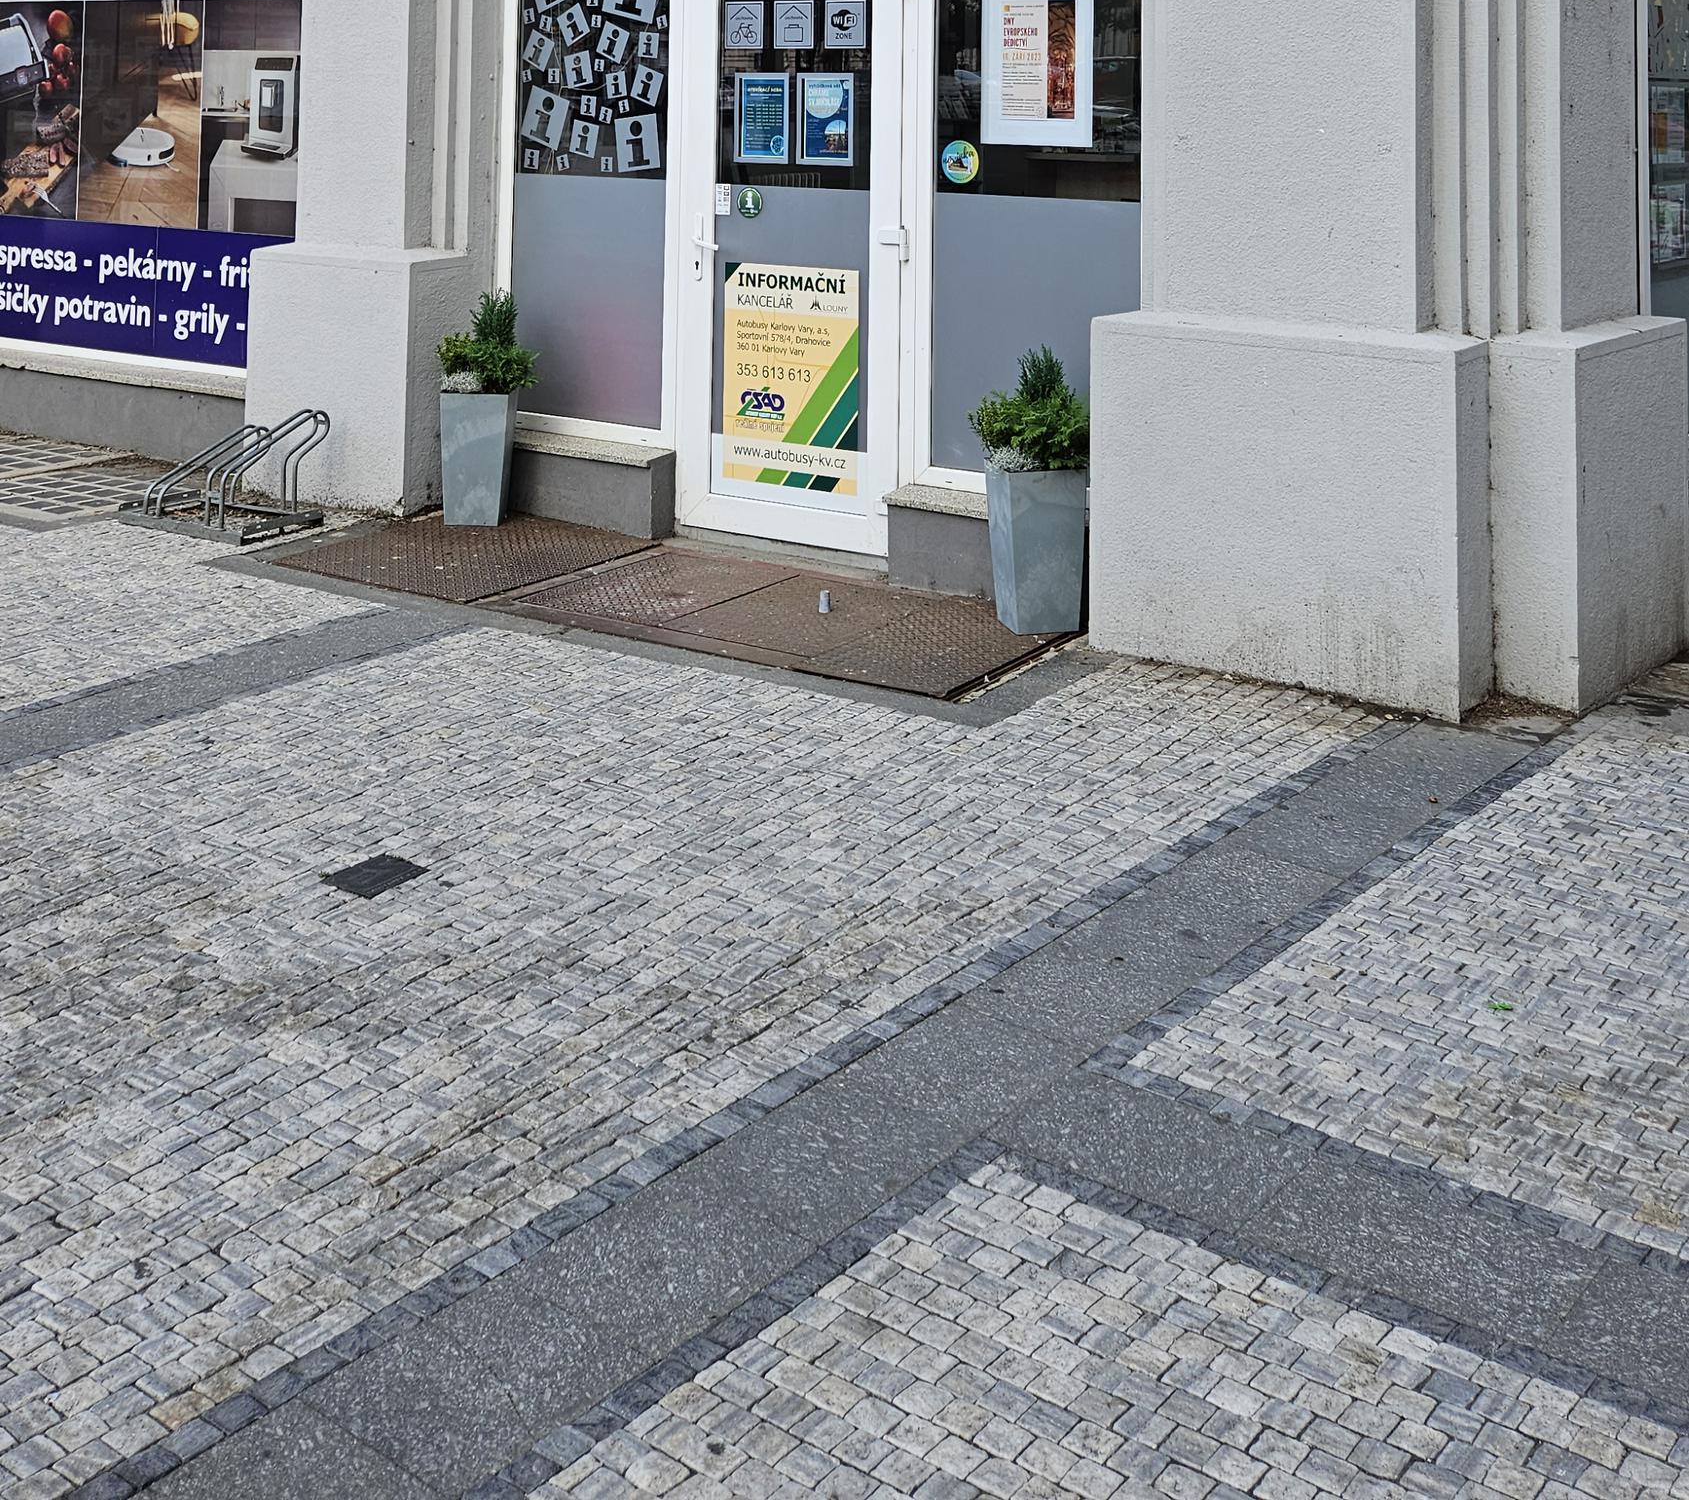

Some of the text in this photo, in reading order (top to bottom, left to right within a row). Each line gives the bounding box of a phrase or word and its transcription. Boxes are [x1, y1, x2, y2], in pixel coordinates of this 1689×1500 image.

[1004, 17, 1014, 26] DNY
[1004, 26, 1038, 37] EVROPSKÉHO
[1004, 36, 1028, 47] DĚDICTVÍ
[99, 248, 196, 292] pekárny
[738, 272, 845, 294] INFORMAČNÍ
[737, 293, 793, 309] KANCELÁŘ
[823, 304, 848, 312] LOUNY
[54, 295, 151, 327] potravin
[173, 302, 230, 345] grily
[737, 319, 768, 331] Autobusy
[770, 322, 796, 333] Karlovy
[798, 324, 815, 335] Vary,
[737, 331, 831, 347] Sportovní 578/4, Drahovice
[737, 342, 805, 357] 360 01 Karlovy Vary
[737, 363, 811, 383] 353 613 613
[734, 445, 846, 469] www.autobusy-kv.cz
